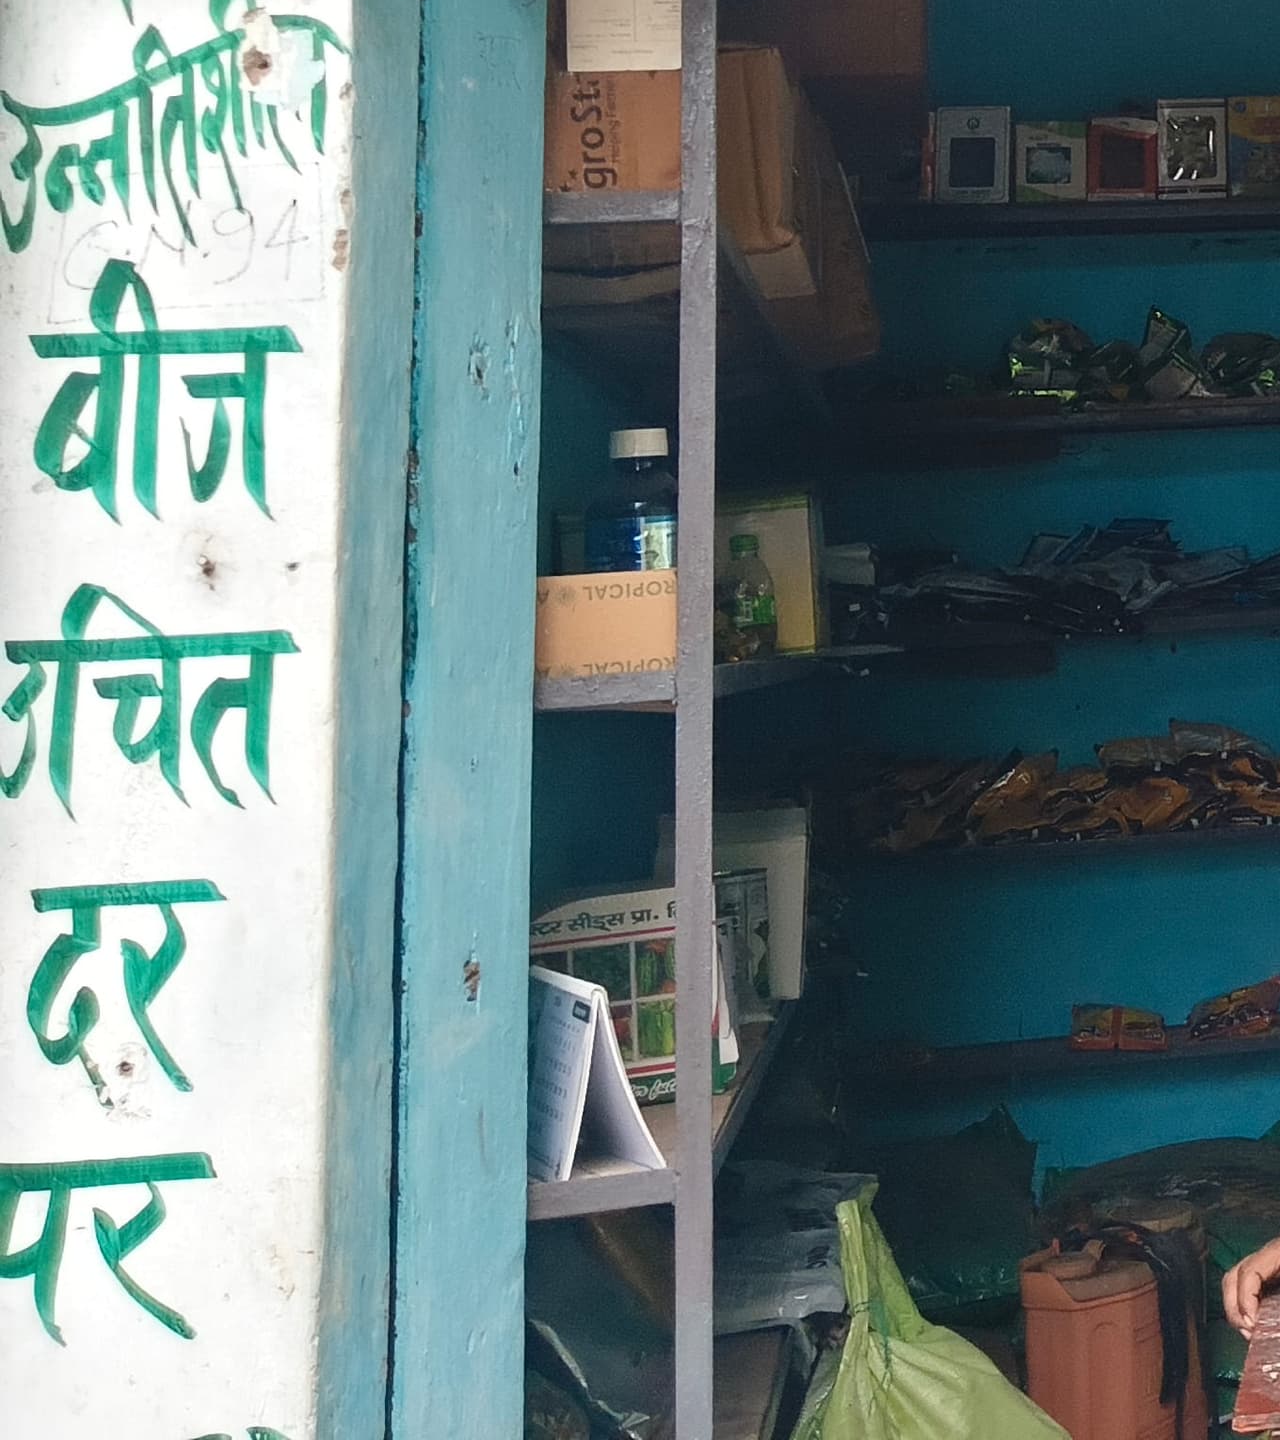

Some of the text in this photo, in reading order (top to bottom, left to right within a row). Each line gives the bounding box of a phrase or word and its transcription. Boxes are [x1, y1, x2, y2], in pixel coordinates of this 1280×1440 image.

[28, 257, 303, 526] बीज
[0, 582, 301, 824] उचित
[583, 579, 677, 602] ROPICAL
[26, 877, 227, 1112] दर
[0, 1151, 218, 1348] पर
